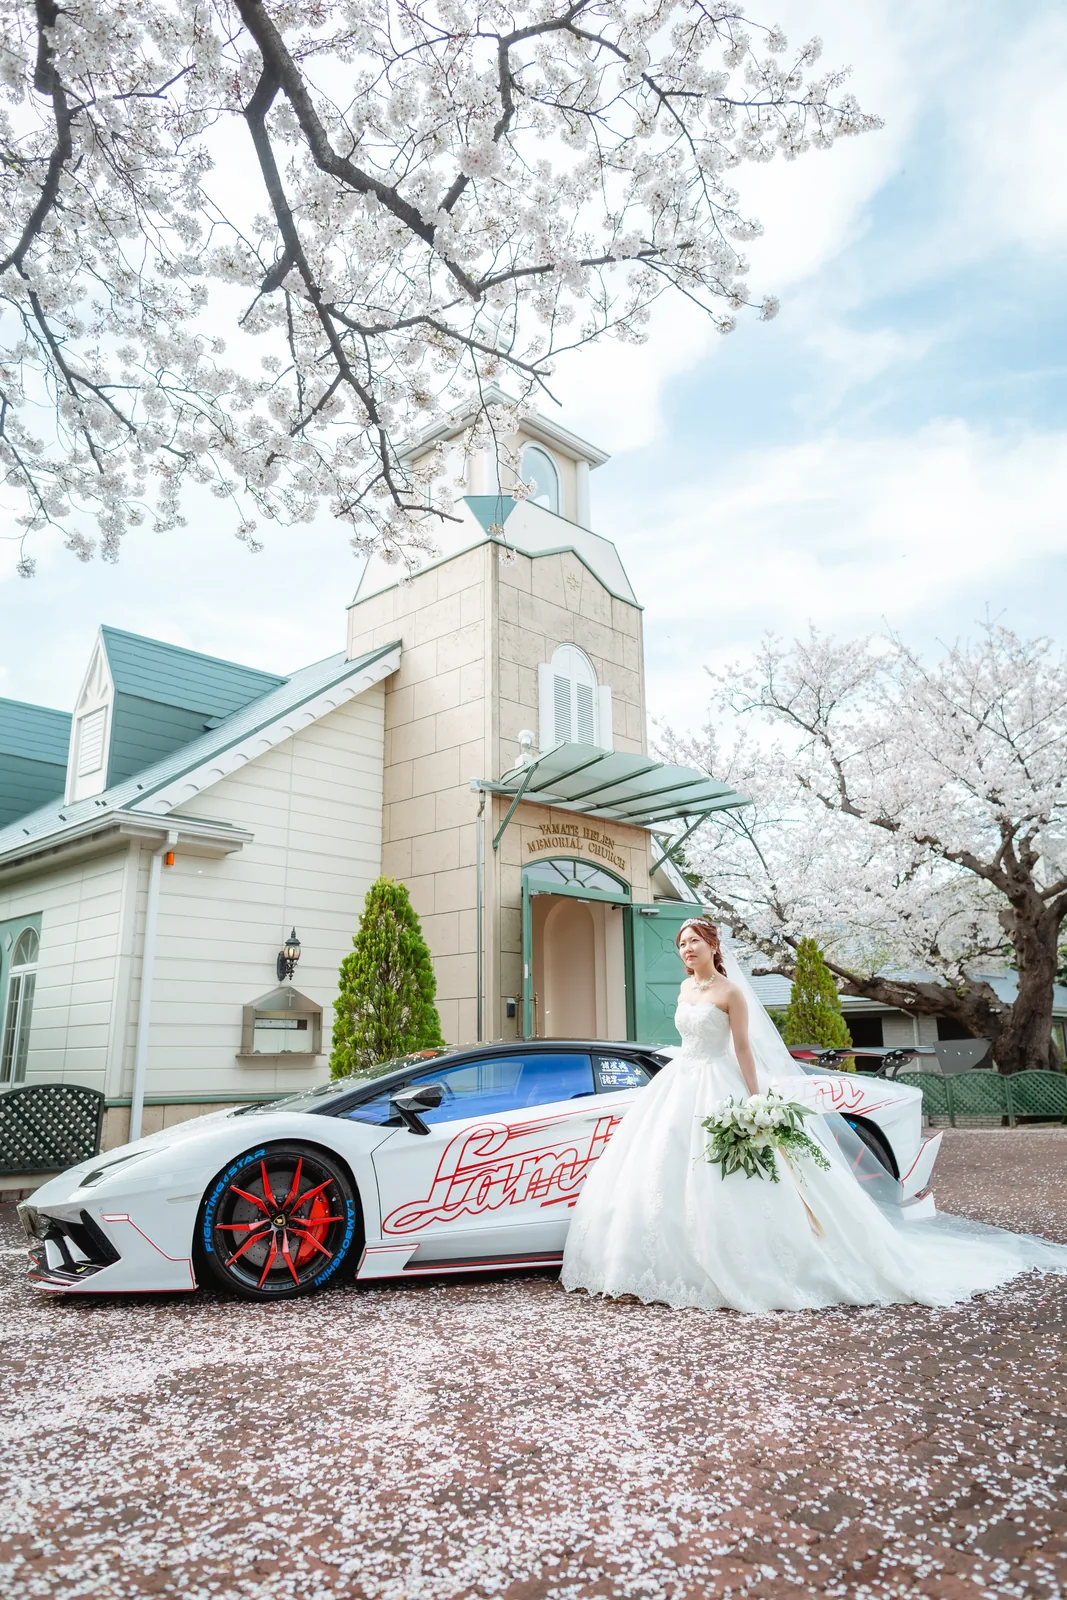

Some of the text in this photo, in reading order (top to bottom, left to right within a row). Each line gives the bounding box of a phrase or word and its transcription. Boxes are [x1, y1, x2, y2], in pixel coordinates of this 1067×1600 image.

[527, 836, 627, 871] MEMORIAL CHURCH
[539, 823, 615, 850] YAMATE HELEN
[203, 1148, 267, 1253] FIGHTING STAR
[314, 1199, 356, 1287] LAMBORGHINI
